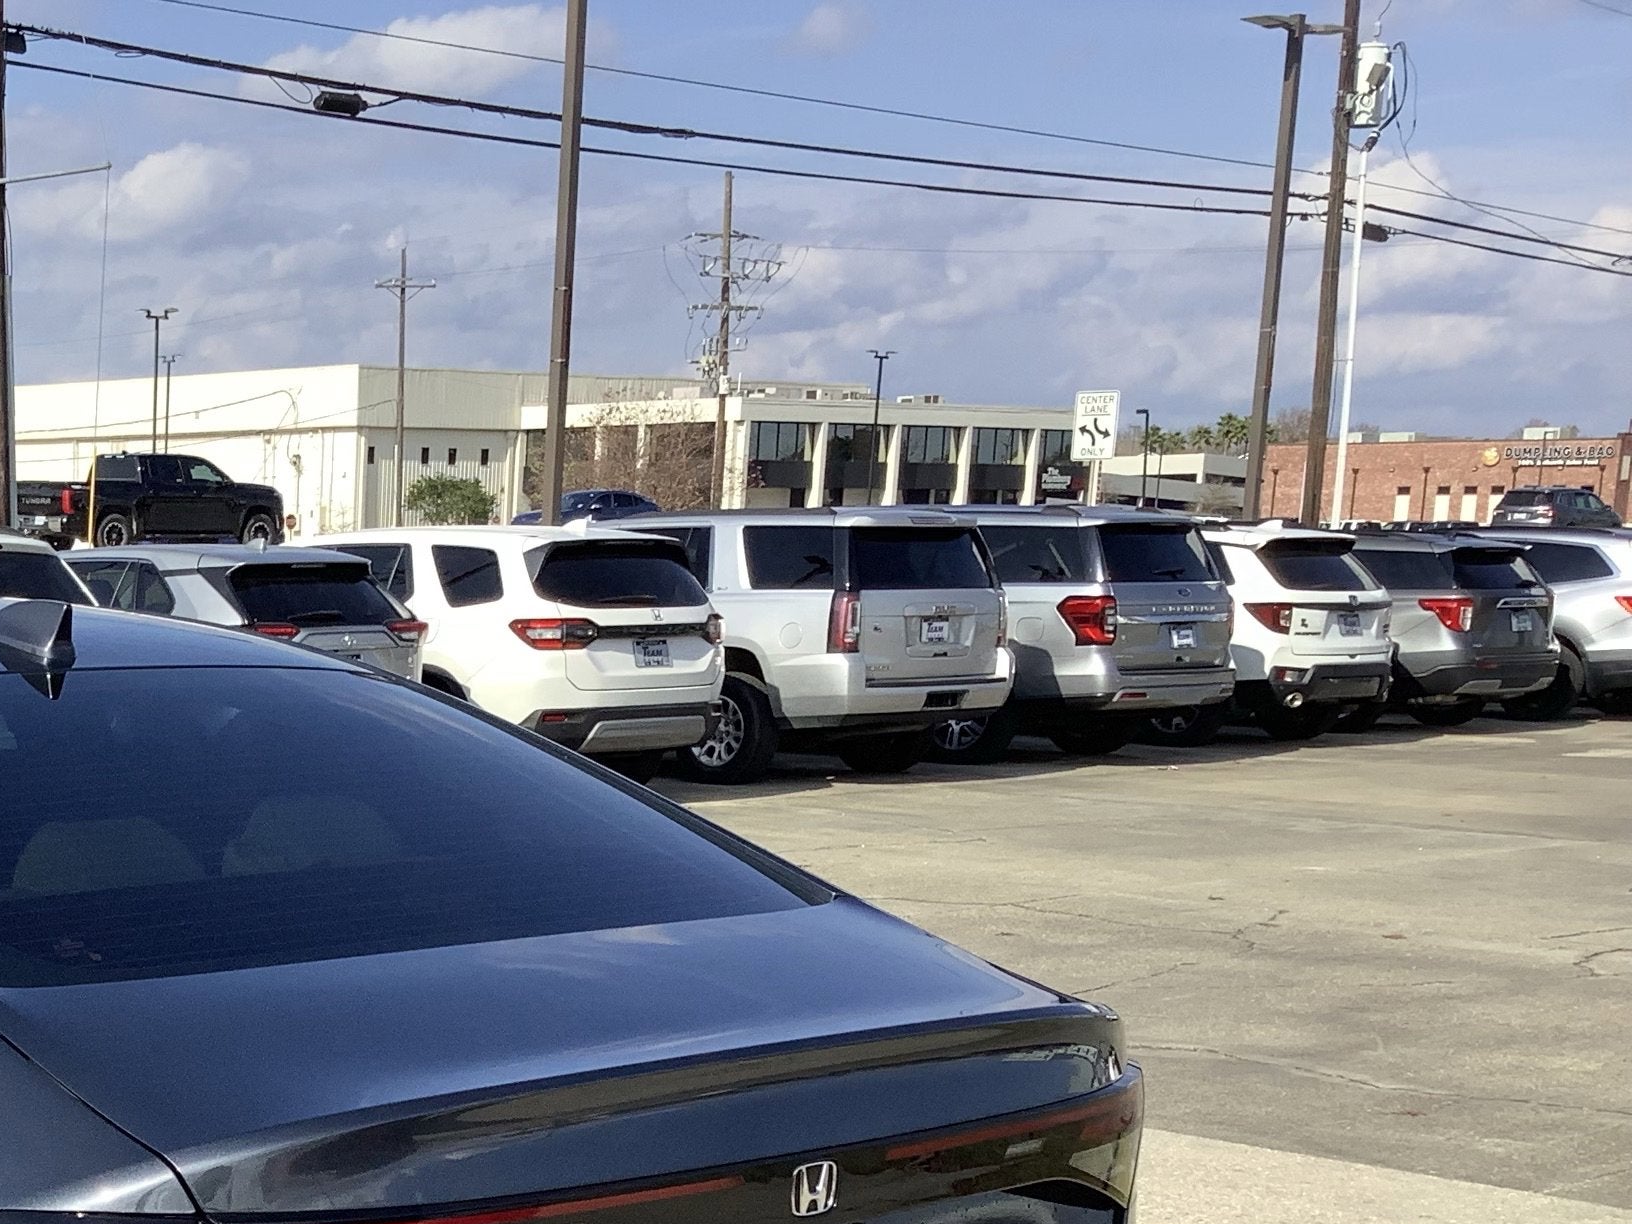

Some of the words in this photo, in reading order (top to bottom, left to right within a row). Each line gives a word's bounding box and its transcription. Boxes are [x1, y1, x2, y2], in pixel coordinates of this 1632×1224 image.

[1080, 395, 1115, 405] CENTER
[1084, 404, 1109, 413] LANE
[1080, 448, 1105, 456] ONLY
[1575, 446, 1587, 457] &
